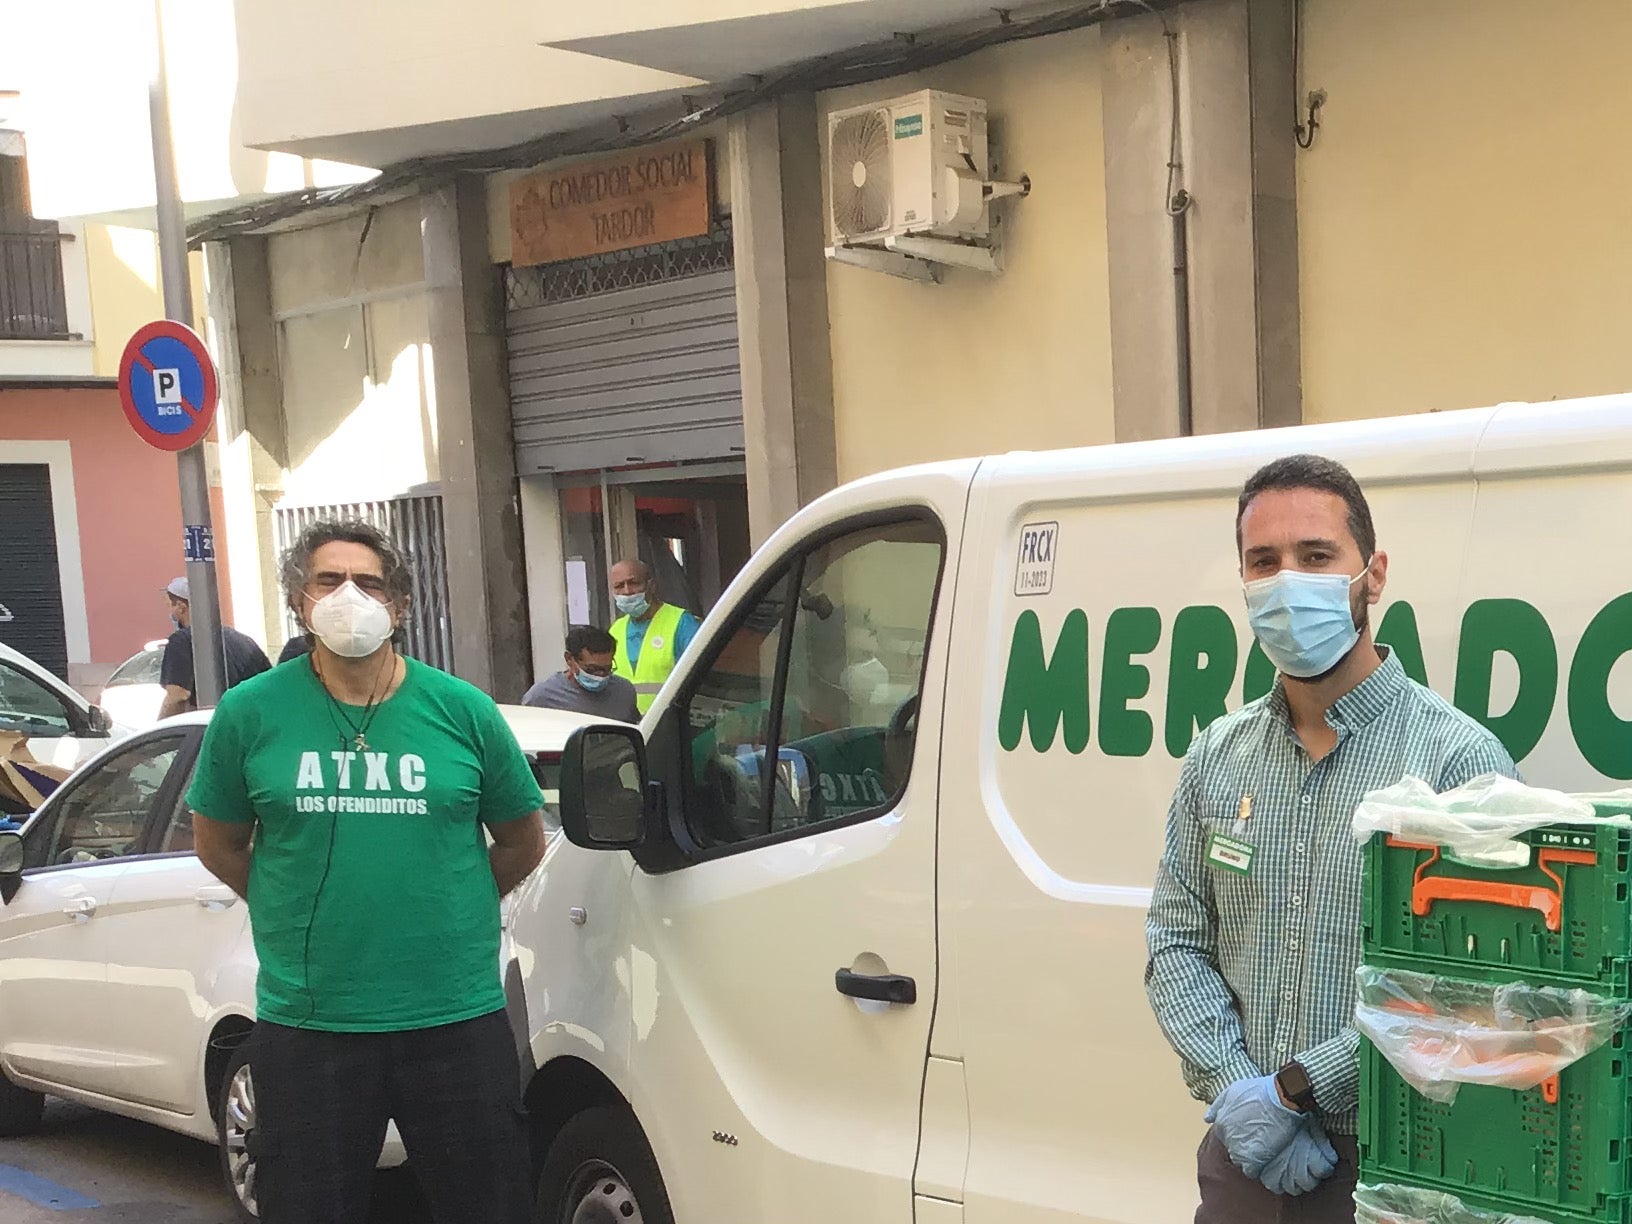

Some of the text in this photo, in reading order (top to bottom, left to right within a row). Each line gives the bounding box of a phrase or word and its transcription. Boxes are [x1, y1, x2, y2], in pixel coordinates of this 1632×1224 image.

[550, 150, 698, 210] COMEDOR SOCIAL
[159, 373, 174, 398] P
[1022, 530, 1053, 563] FRCX
[296, 796, 427, 815] LOS OFENDIDITOS
